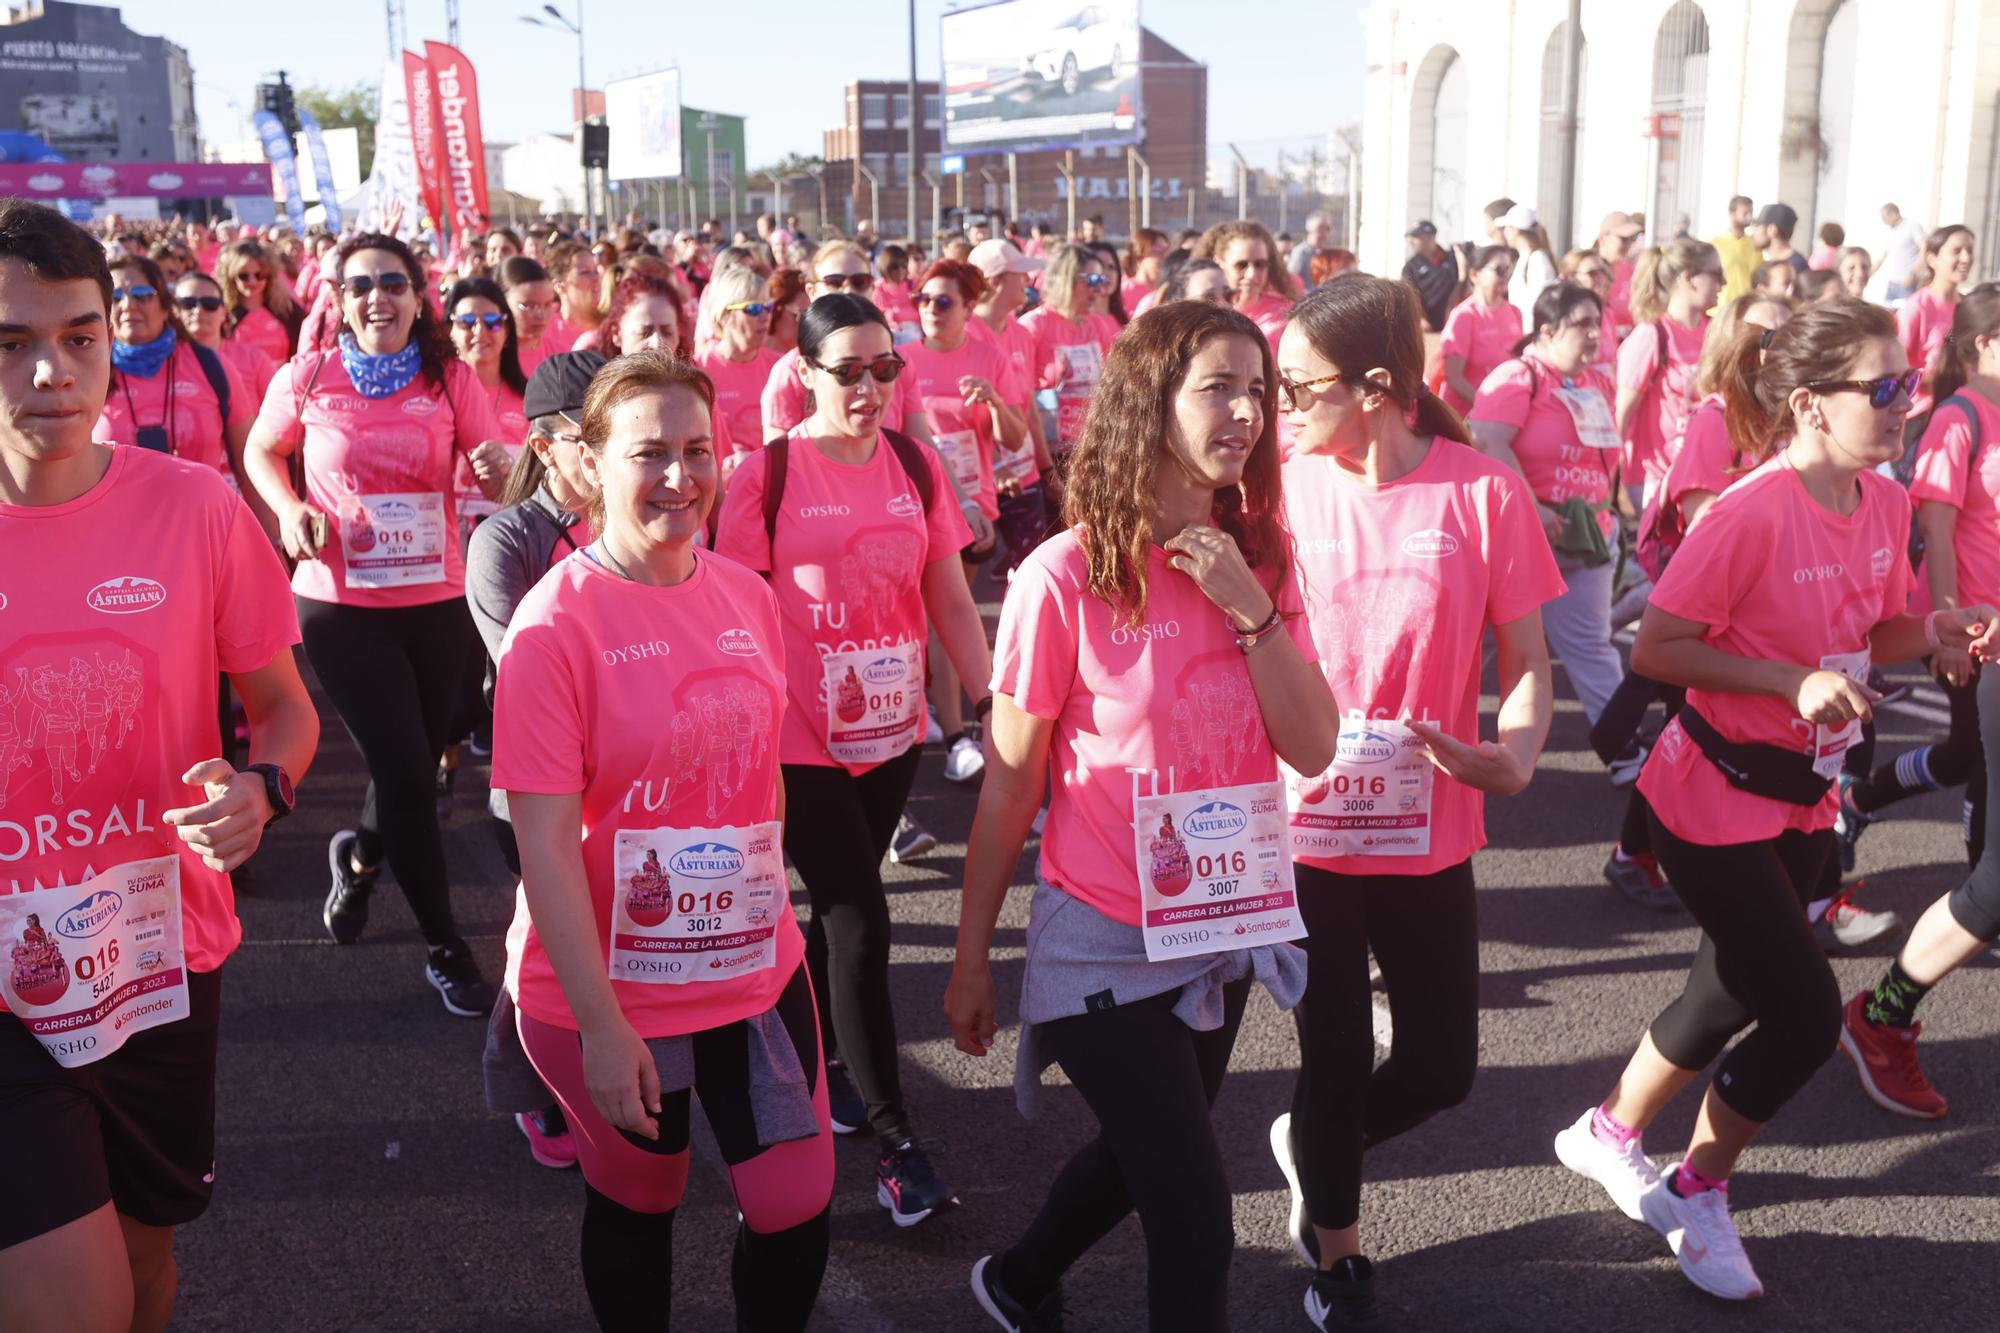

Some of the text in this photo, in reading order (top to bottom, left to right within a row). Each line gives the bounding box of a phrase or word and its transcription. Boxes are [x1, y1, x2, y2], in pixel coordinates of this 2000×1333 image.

[438, 63, 480, 227] Santander
[1560, 444, 1582, 463] TU
[800, 504, 850, 518] OYSHO
[379, 529, 413, 544] 016
[386, 546, 408, 555] 2674
[94, 591, 161, 606] ASTURIANA
[808, 602, 846, 630] TU
[1111, 620, 1180, 645] OYSHO
[602, 640, 671, 666] OYSHO
[869, 691, 903, 710] 016
[878, 712, 897, 723] 1934
[839, 746, 876, 756] OYSHO
[1333, 775, 1386, 795] 016
[623, 777, 670, 813] TU
[1251, 803, 1278, 815] SUMA
[1342, 800, 1375, 811] 3006
[0, 799, 154, 862] ORSAL
[1190, 817, 1243, 832] ASTURIANA
[1301, 817, 1417, 827] CARRERA DE LA MUJER 2023
[1294, 835, 1339, 848] OYSHO
[1375, 836, 1419, 846] Santander
[748, 844, 772, 856] SUMA
[676, 856, 741, 870] ASTURIANA
[1196, 850, 1246, 877] 016
[128, 878, 165, 895] SUMA
[1208, 880, 1239, 896] 3007
[677, 890, 733, 914] 016
[1163, 897, 1284, 921] CARRERA DE LA MUJER 2023
[64, 901, 117, 934] ASTURIANA
[687, 917, 722, 932] 3012
[1246, 918, 1290, 934] Santander
[633, 940, 683, 950] CARRERA
[685, 941, 699, 950] DE
[701, 939, 713, 949] LA
[715, 936, 746, 947] MUJER
[1161, 930, 1210, 947] OYSHO
[74, 938, 120, 980] 016
[627, 959, 682, 973] OYSHO
[723, 949, 764, 968] Santander
[92, 971, 114, 999] 5427
[34, 976, 167, 1031] CARRERA DE LA MUJER 2023
[121, 998, 174, 1025] Santander
[47, 1036, 97, 1056] YSHO
